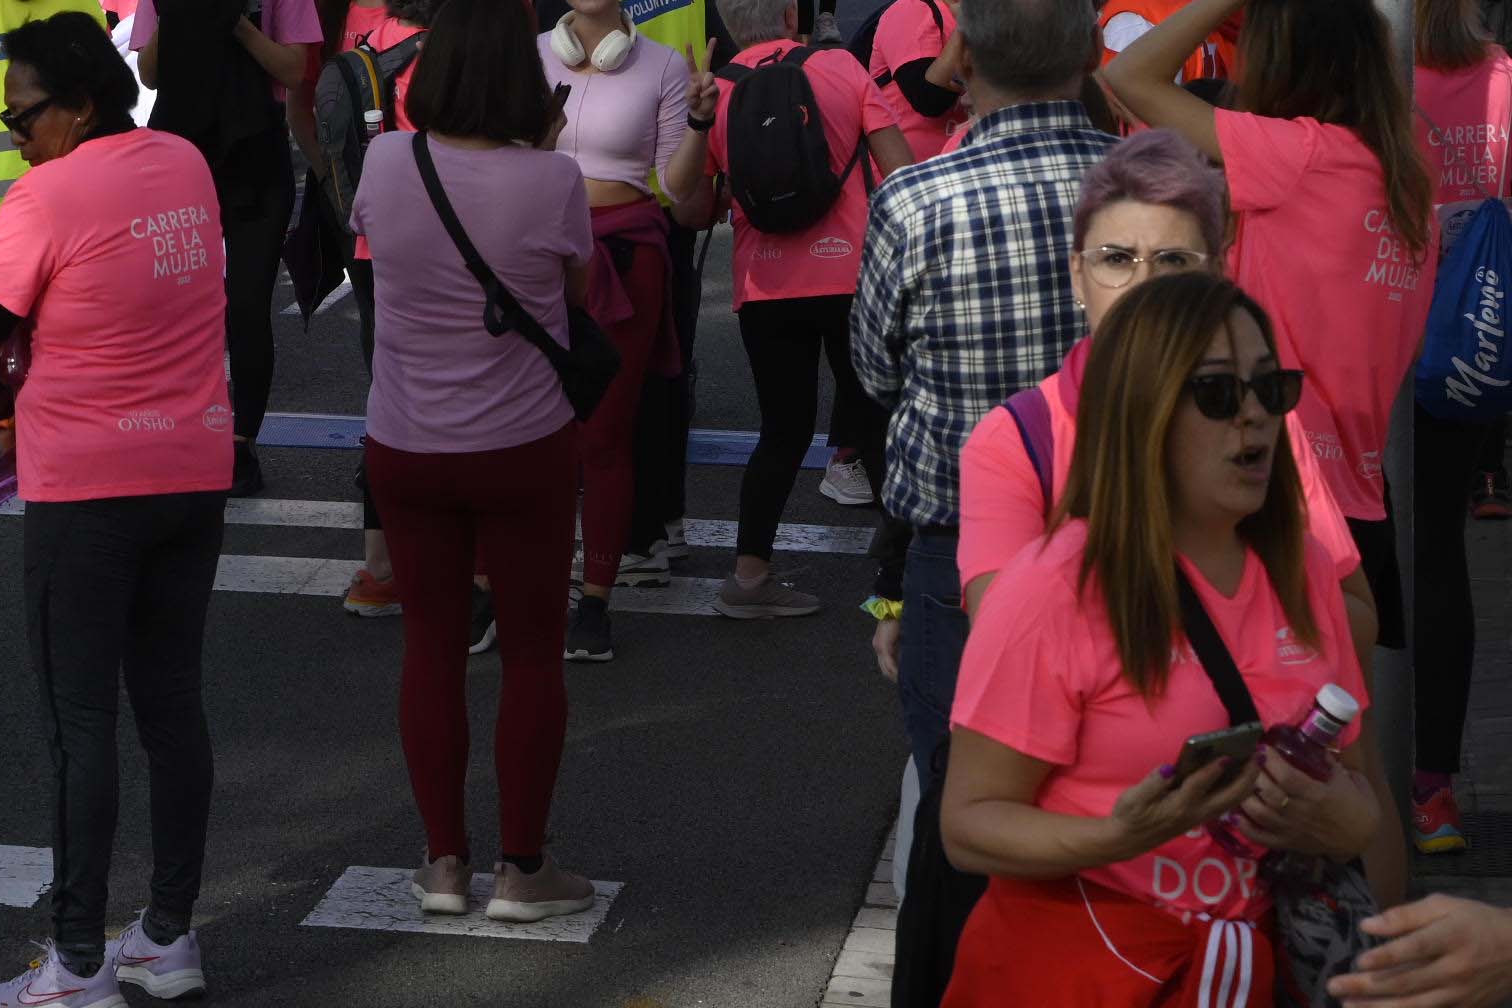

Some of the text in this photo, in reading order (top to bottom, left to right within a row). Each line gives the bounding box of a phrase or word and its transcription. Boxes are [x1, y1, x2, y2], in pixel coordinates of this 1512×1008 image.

[1428, 123, 1509, 147] CARRERA
[1444, 145, 1495, 166] DE LA
[1440, 165, 1498, 188] MUJER
[130, 206, 209, 240] CARRERA
[153, 230, 203, 257] DE LA
[1377, 236, 1400, 263] DE
[153, 249, 208, 280] MUJER
[118, 417, 175, 432] OYSHO
